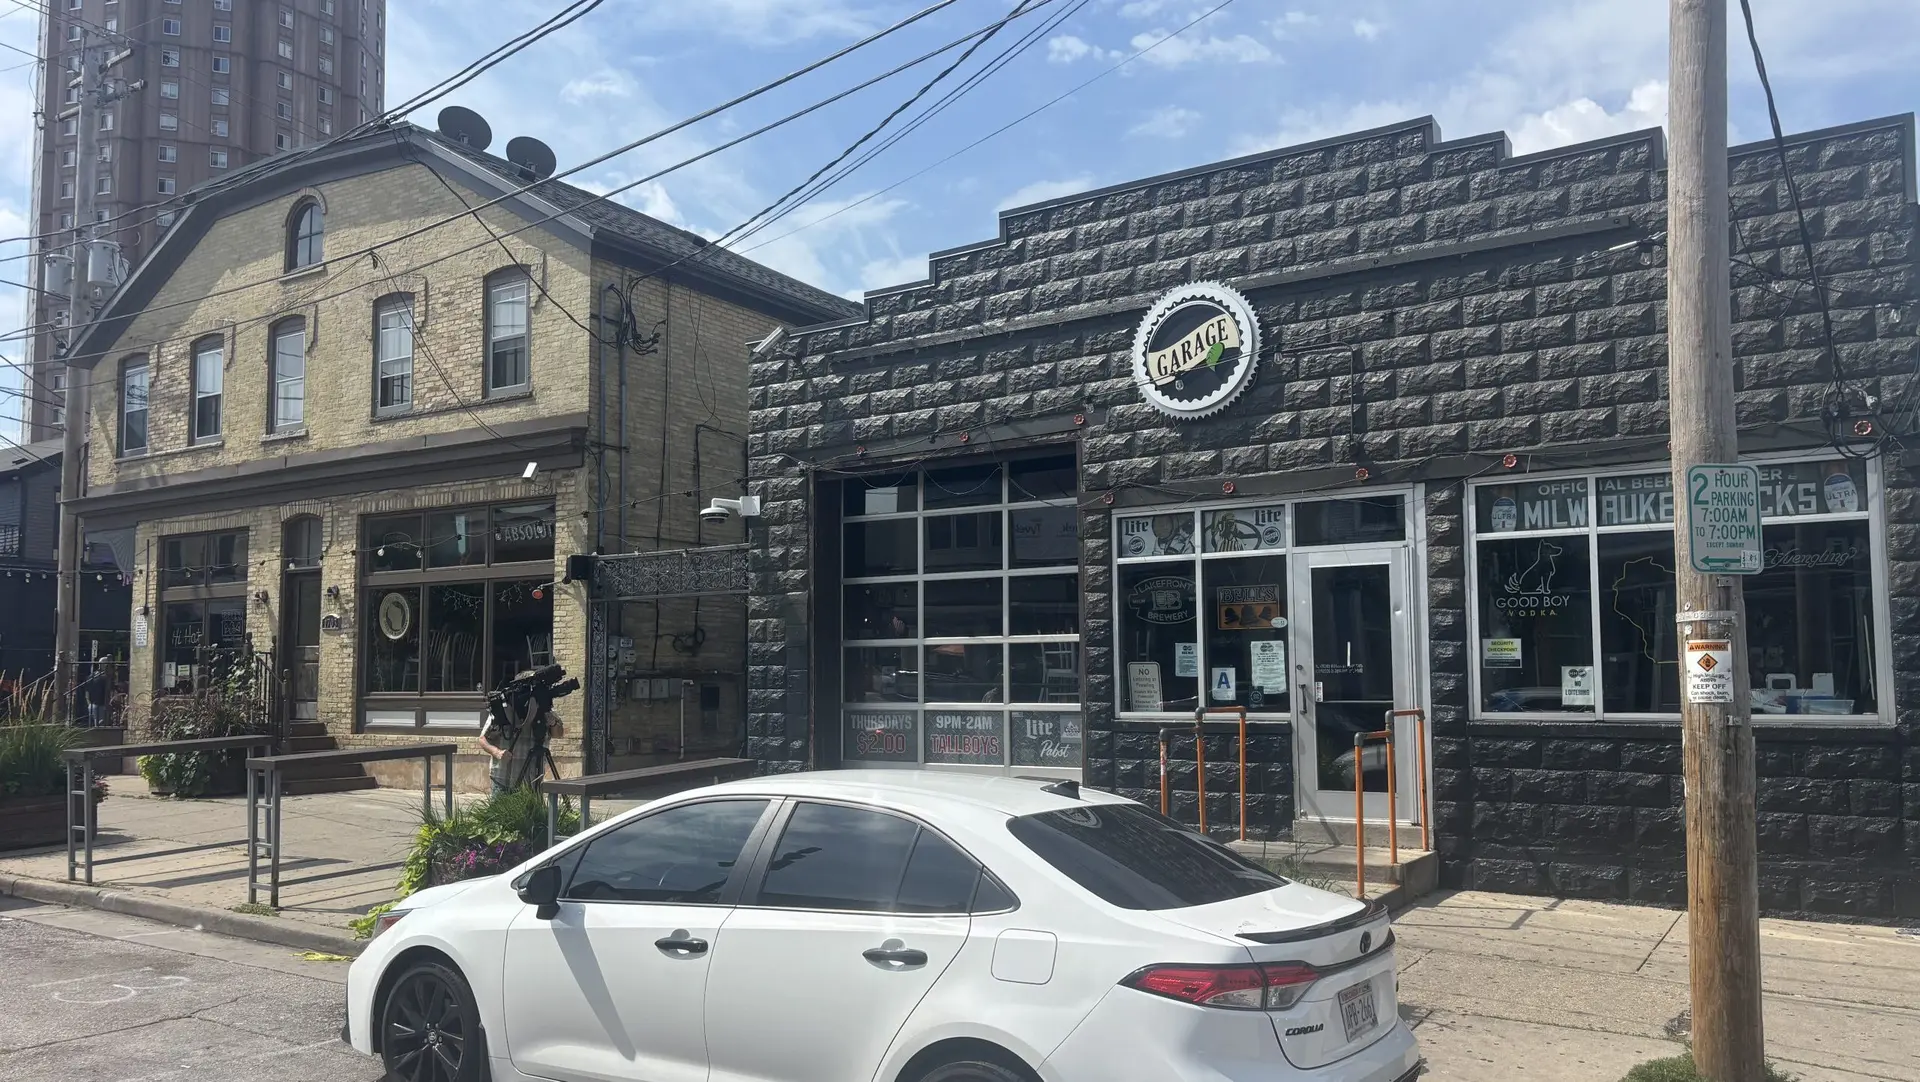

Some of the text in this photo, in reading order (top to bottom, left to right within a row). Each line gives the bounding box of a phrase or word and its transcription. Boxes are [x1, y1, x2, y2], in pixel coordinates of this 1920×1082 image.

[1157, 318, 1229, 377] GARAGE
[1693, 473, 1709, 505] 2
[1714, 472, 1748, 488] HOUR
[1825, 488, 1856, 501] ULTRA
[1524, 483, 1817, 529] MILWAUKE CKS
[1711, 491, 1754, 507] PARKING
[1254, 509, 1282, 526] Lite
[1701, 508, 1747, 522] 7:00AM
[505, 522, 553, 541] ABSOLUT
[1124, 520, 1149, 536] Lite
[1695, 525, 1755, 540] TO 7:00PM
[1763, 546, 1858, 568] Yuengling
[1138, 579, 1192, 593] LAKEFRONT
[1220, 587, 1276, 602] BELL'S
[1496, 595, 1570, 608] GOOD BOY
[1148, 610, 1188, 621] BREWERY
[1508, 609, 1557, 617] VODKA
[1694, 642, 1726, 650] WARNING
[1138, 668, 1150, 676] NO
[1217, 671, 1231, 689] A
[851, 714, 912, 730] THURSDAYS
[935, 715, 992, 730] 9PM-2AM
[1025, 718, 1054, 739] Lite
[857, 733, 905, 754] $2.00
[931, 734, 999, 755] TALLBOYS
[1040, 739, 1071, 758] Pabst
[1285, 1023, 1324, 1036] COROLLA
